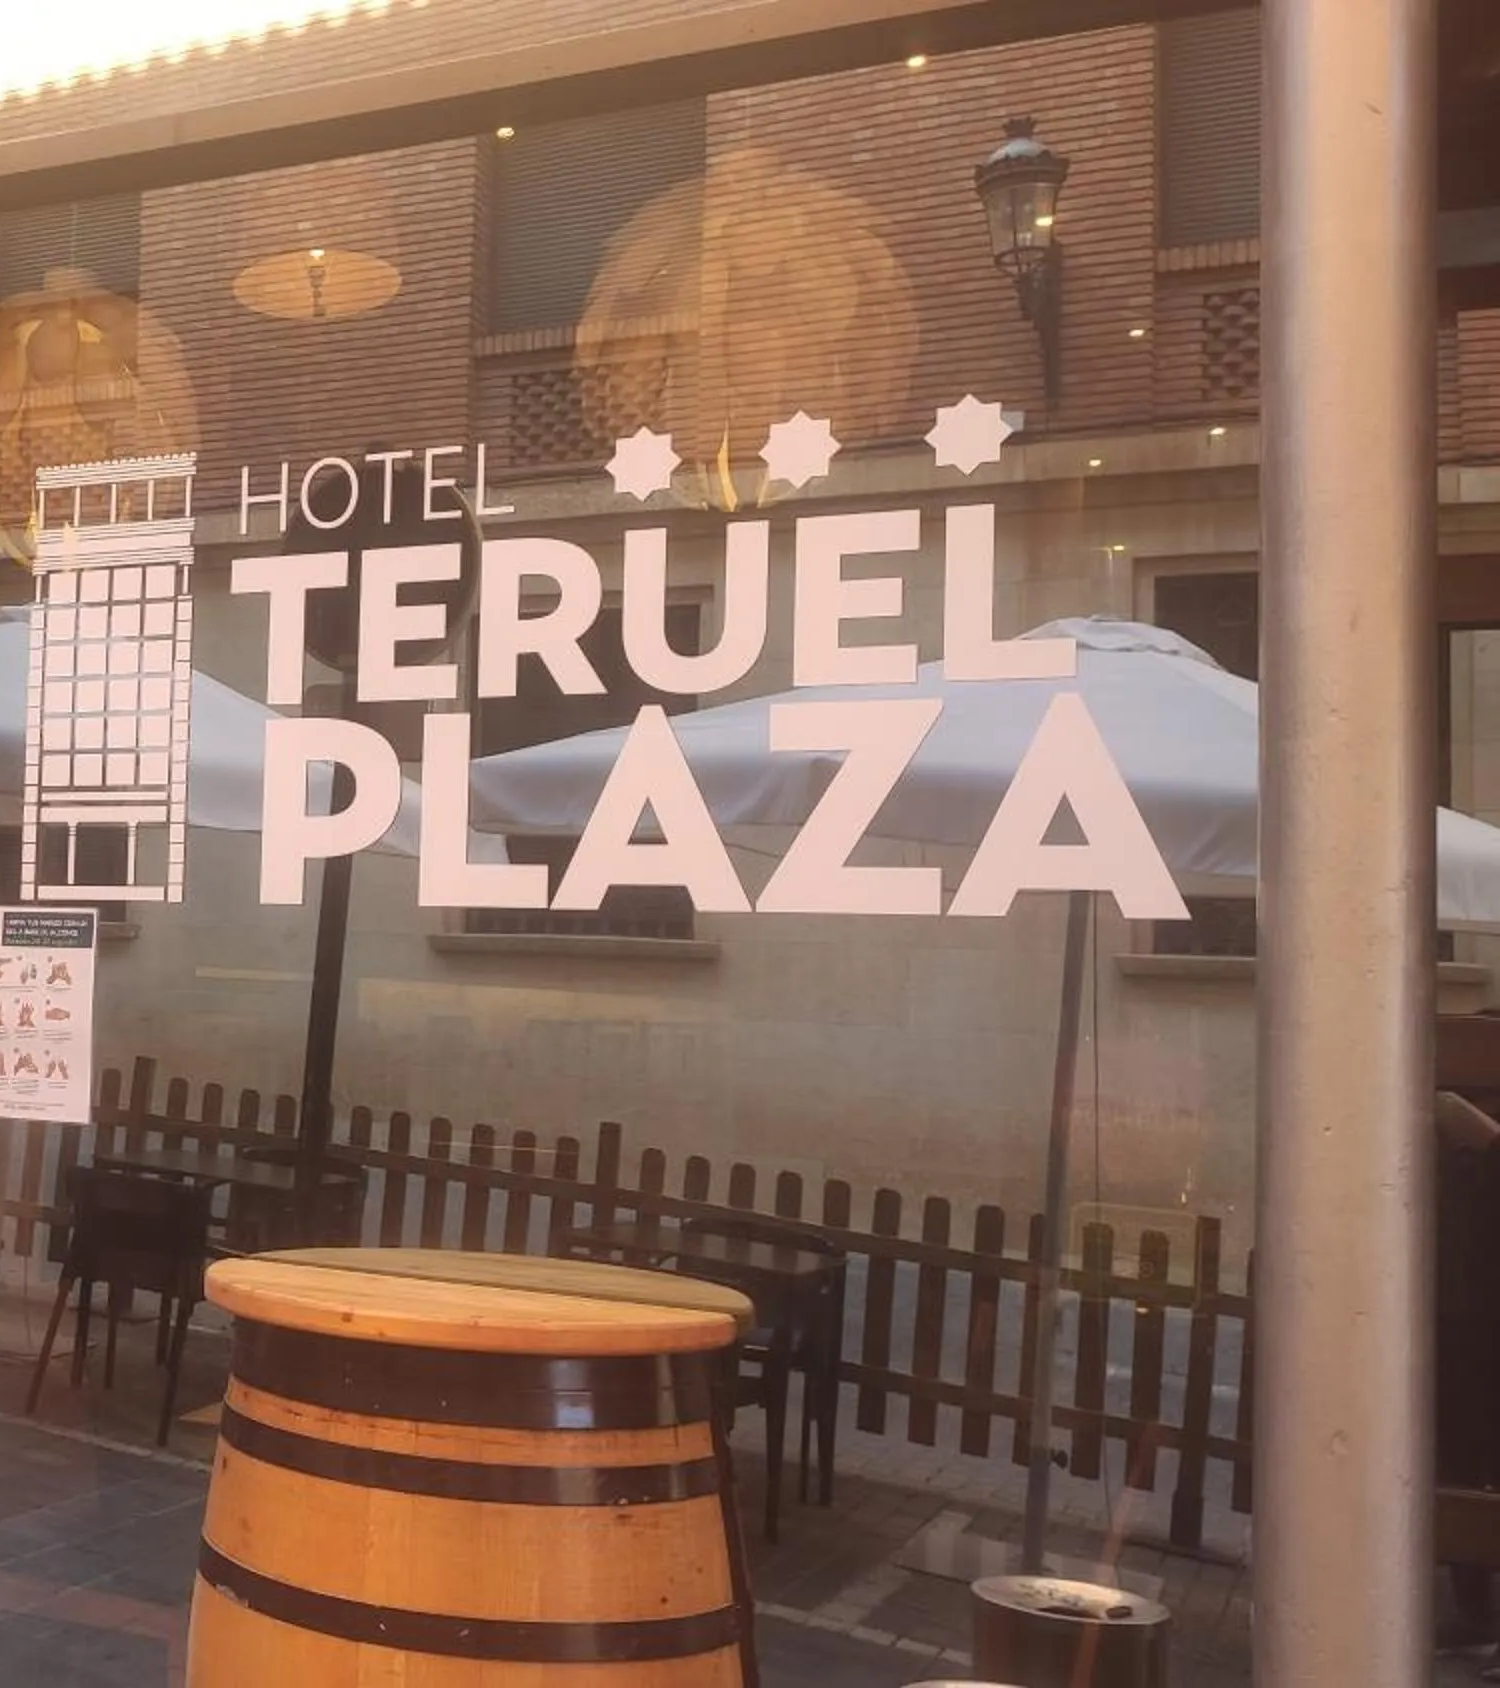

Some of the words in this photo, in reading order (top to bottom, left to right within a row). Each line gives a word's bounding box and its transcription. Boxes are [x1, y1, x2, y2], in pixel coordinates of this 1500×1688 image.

[239, 443, 515, 536] HOTEL
[229, 503, 1079, 706] TERUEL
[259, 692, 1193, 921] PLAZA
